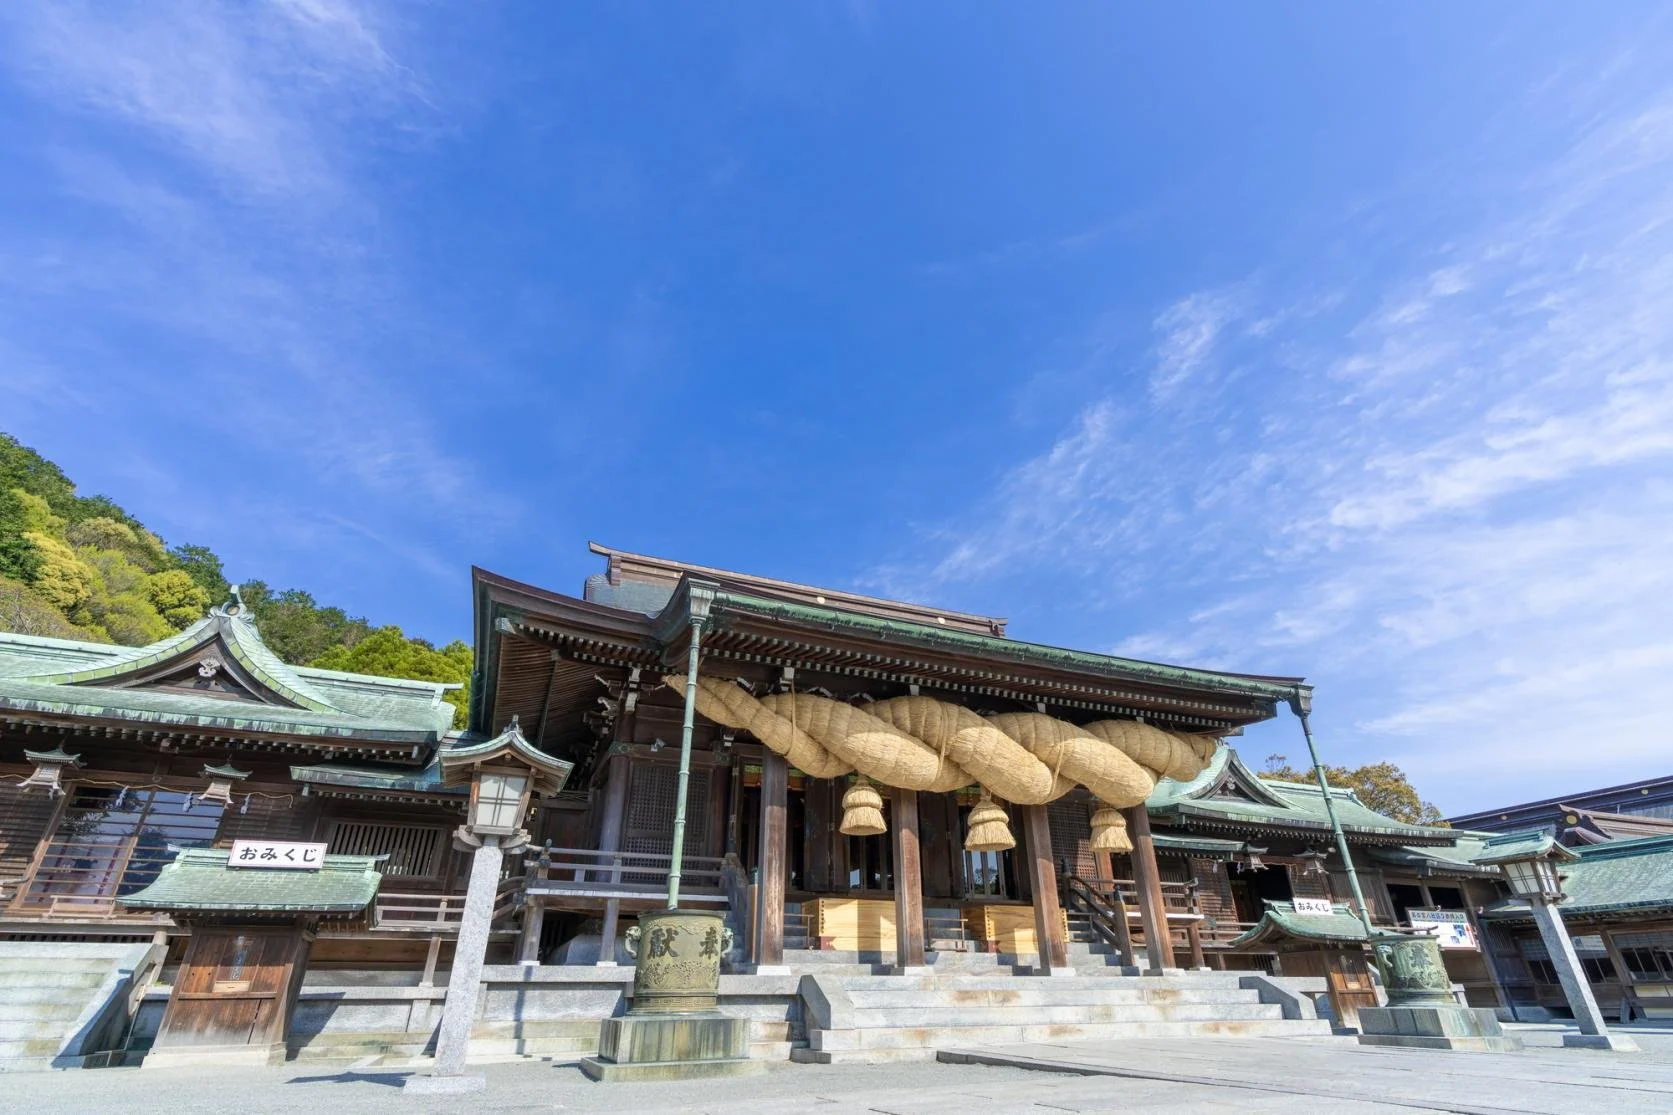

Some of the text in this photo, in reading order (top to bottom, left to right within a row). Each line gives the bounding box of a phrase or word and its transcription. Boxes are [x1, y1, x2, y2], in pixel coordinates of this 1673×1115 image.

[240, 847, 317, 862] おみくじ
[1298, 902, 1329, 912] おみくじ
